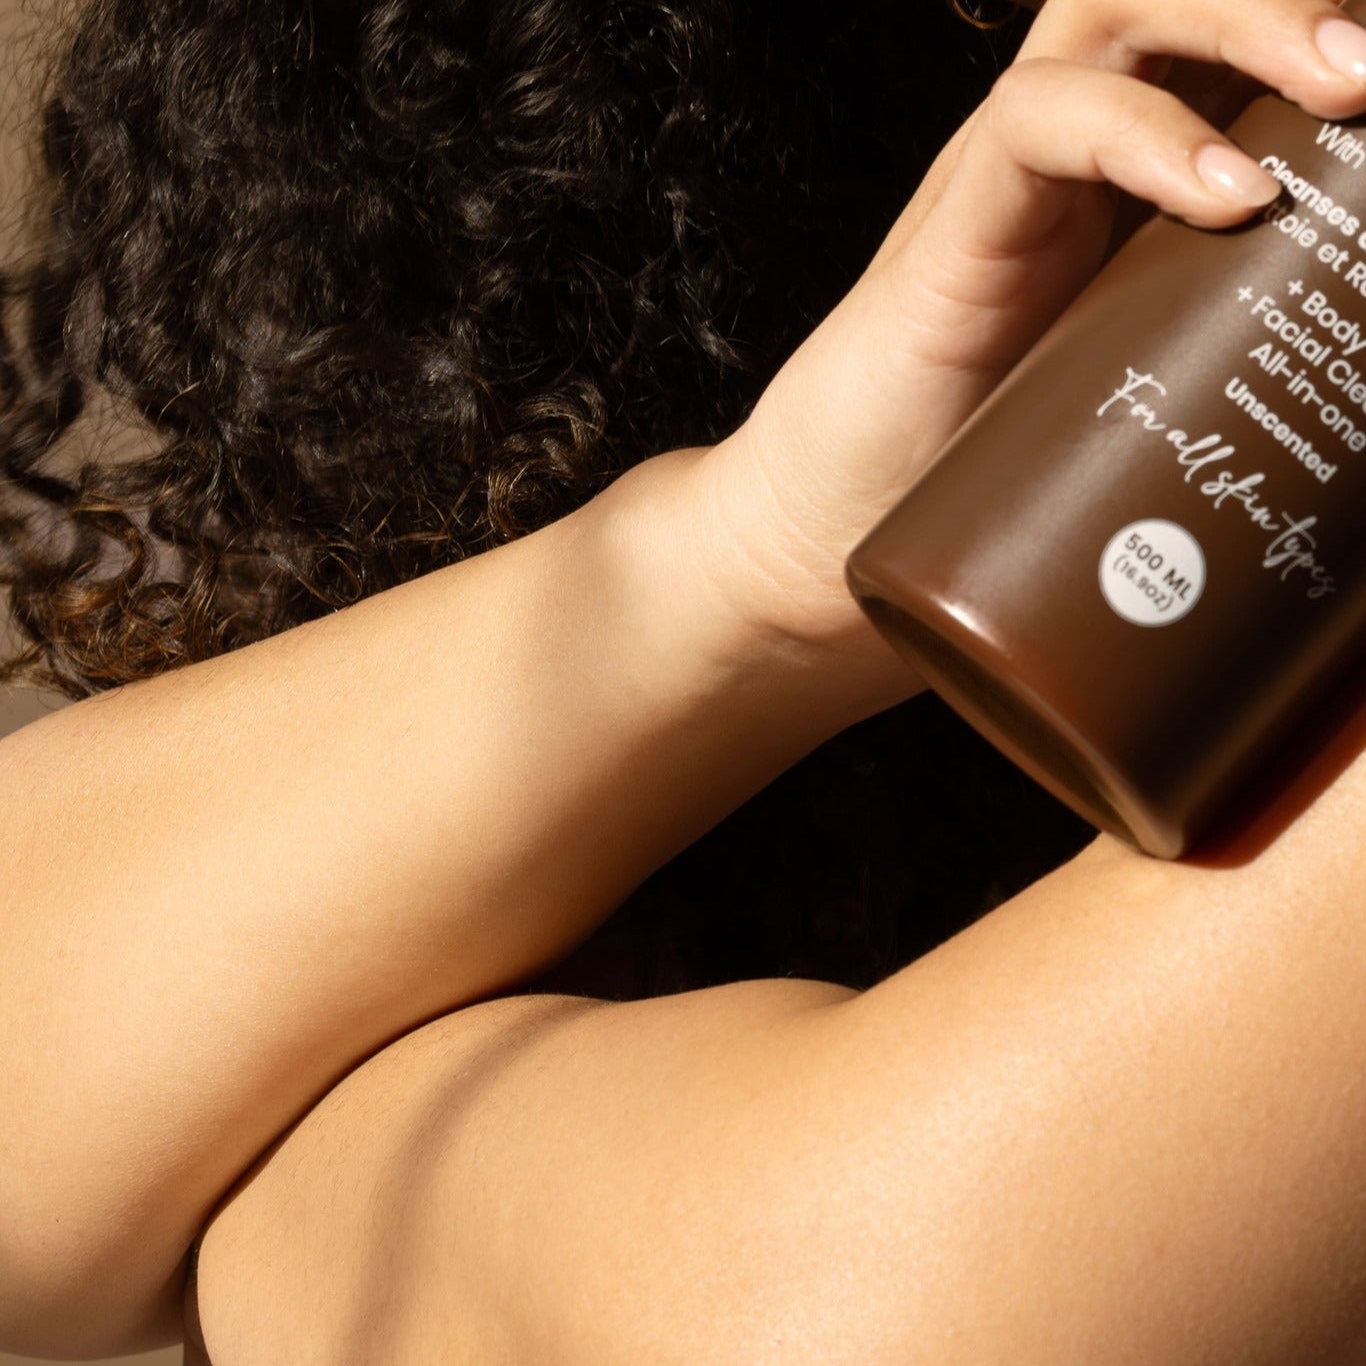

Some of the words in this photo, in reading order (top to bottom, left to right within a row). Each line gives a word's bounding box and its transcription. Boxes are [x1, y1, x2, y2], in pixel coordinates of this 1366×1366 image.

[1315, 122, 1366, 170] With
[1287, 279, 1304, 296] +
[1317, 243, 1350, 273] et
[1237, 286, 1253, 302] +
[1250, 295, 1333, 367] Facial
[1096, 366, 1167, 430] For
[1166, 429, 1235, 483] all
[1224, 376, 1338, 484] Unscented
[1200, 471, 1280, 530] skin
[1125, 532, 1164, 570] 500
[1162, 568, 1191, 601] ML
[1262, 510, 1337, 599] types
